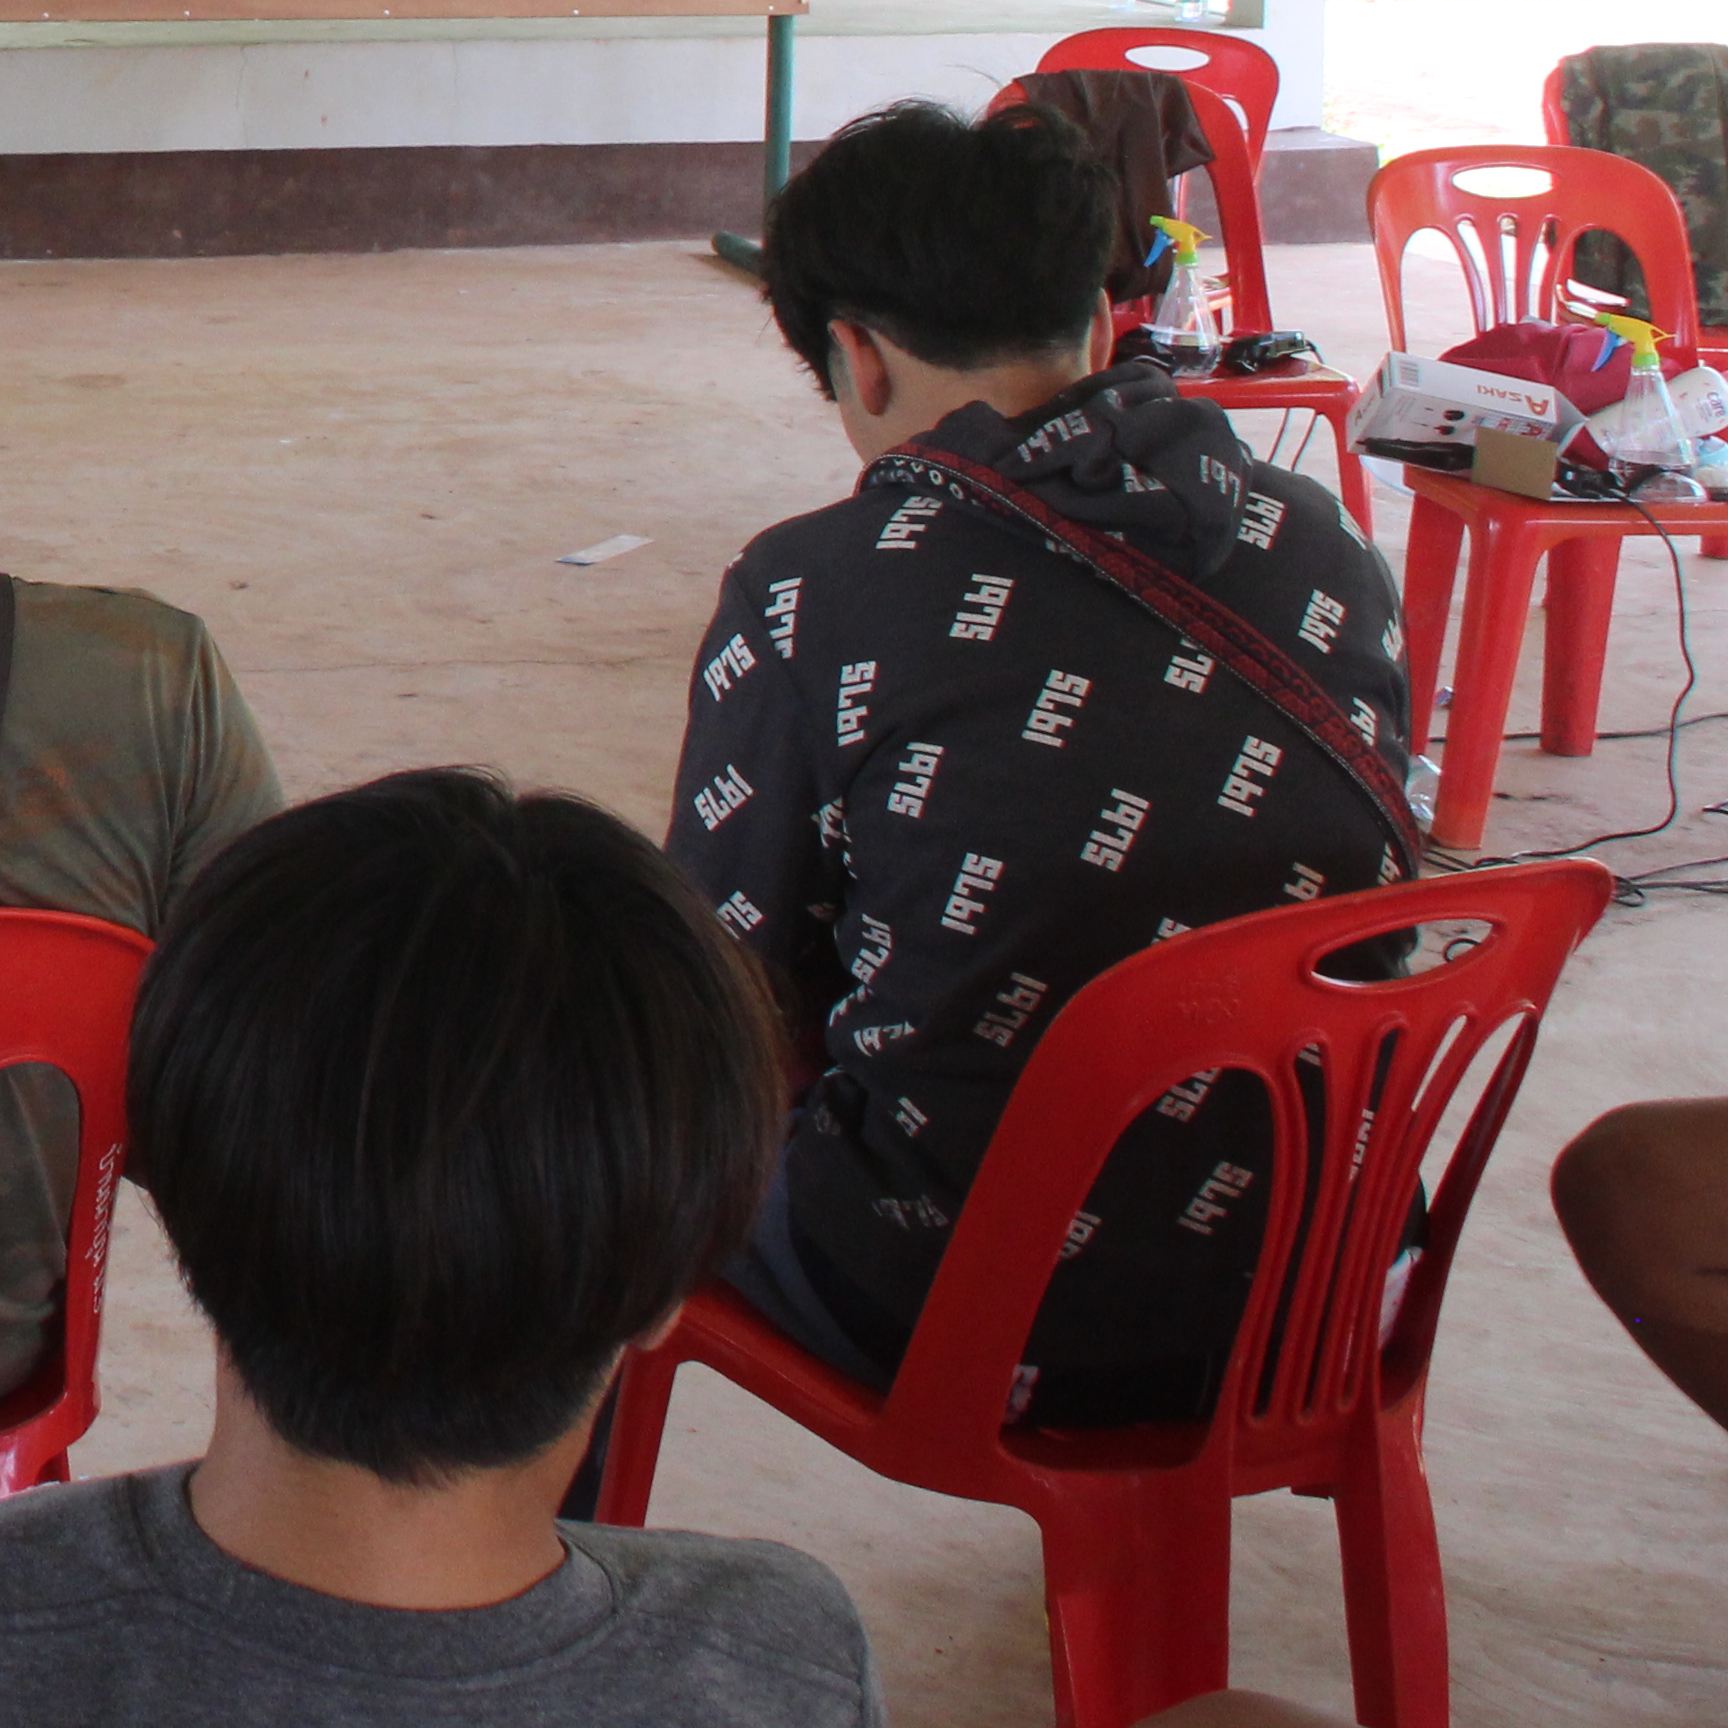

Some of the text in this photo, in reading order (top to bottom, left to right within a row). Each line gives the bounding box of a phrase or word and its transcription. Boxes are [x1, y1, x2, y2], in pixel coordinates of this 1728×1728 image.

[1199, 454, 1242, 508] 197
[875, 494, 944, 551] 1975
[1236, 491, 1287, 551] 1975
[948, 572, 1015, 641] 1975
[1297, 588, 1346, 654] 1975
[703, 632, 757, 702] 1975
[1163, 637, 1217, 695] 75
[836, 660, 878, 748] 1975
[1021, 668, 1091, 748] 1975
[693, 763, 755, 832] 1975
[886, 741, 945, 819] 1975
[1216, 734, 1283, 818] 1975
[1079, 787, 1150, 872] 1975
[940, 851, 1004, 936] 1975
[973, 971, 1049, 1047] 1975
[1176, 1160, 1255, 1236] 1975
